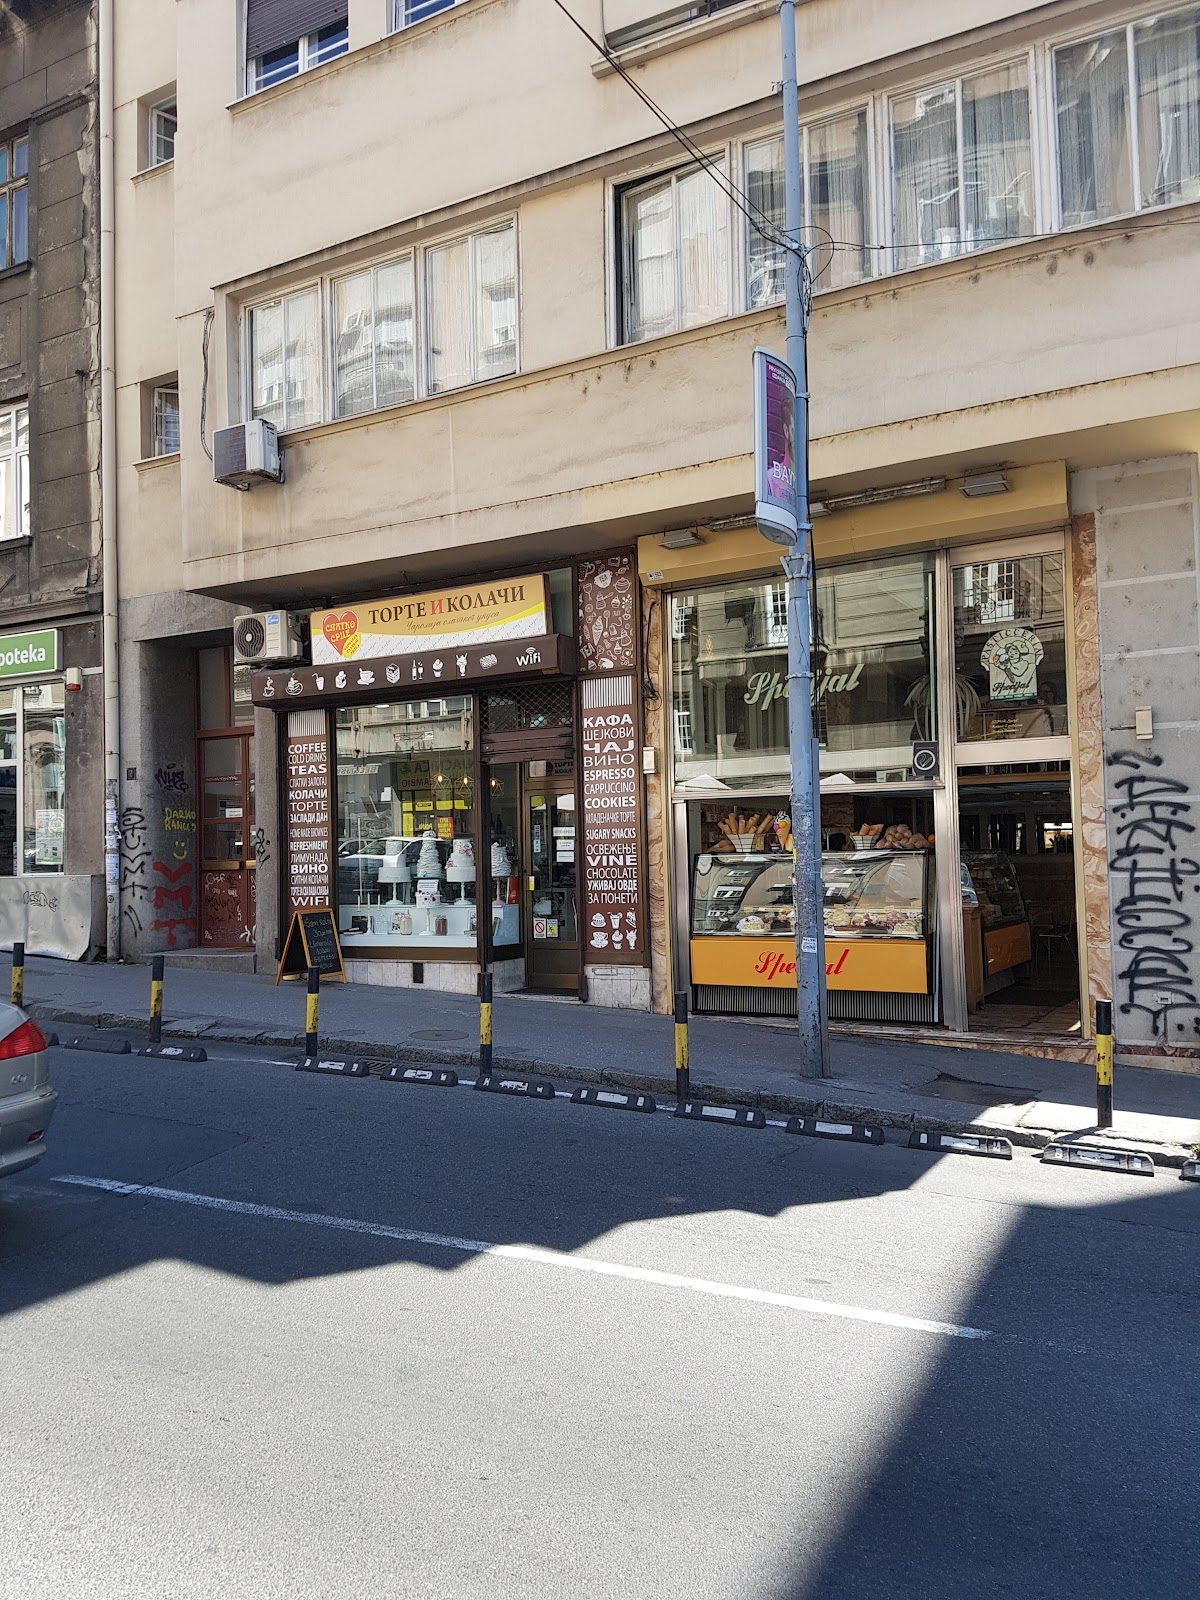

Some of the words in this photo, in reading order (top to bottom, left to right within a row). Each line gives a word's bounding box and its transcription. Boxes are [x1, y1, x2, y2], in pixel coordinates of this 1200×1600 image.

[368, 601, 427, 624] ТОРТЕ
[430, 598, 445, 615] И
[446, 585, 526, 613] КОЛАЧИ
[583, 713, 633, 729] КАФА
[583, 727, 634, 741] ШЕЈКОВИ
[288, 742, 327, 754] COFFEE
[583, 740, 635, 754] ЧАЈ
[288, 754, 305, 765] COLD
[305, 752, 327, 763] DRINKS
[583, 753, 635, 767] ВИНО
[289, 764, 328, 776] TEAS
[584, 767, 635, 781] ESPRESSO
[584, 781, 636, 795] CAPPUCCINO
[289, 789, 328, 800] КОЛАЧИ
[290, 800, 328, 812] ТОРТЕ
[585, 795, 636, 809] COOKIES
[316, 812, 329, 824] ДАН
[619, 811, 636, 823] ТОРТЕ
[586, 828, 611, 840] SUGARY
[612, 827, 637, 839] SNACKS
[586, 843, 637, 855] ОСВЕЖЕЊЕ
[291, 852, 329, 864] ЛИМУНАДА
[586, 854, 638, 866] VINE
[291, 863, 329, 875] ВИНО
[586, 867, 638, 880] CHOCOLATE
[588, 880, 617, 891] УЖИВАЈ
[617, 879, 638, 893] ОВДЕ
[291, 895, 329, 907] WIFI
[588, 893, 600, 904] ЗА
[601, 892, 638, 904] ПОНЕТИ
